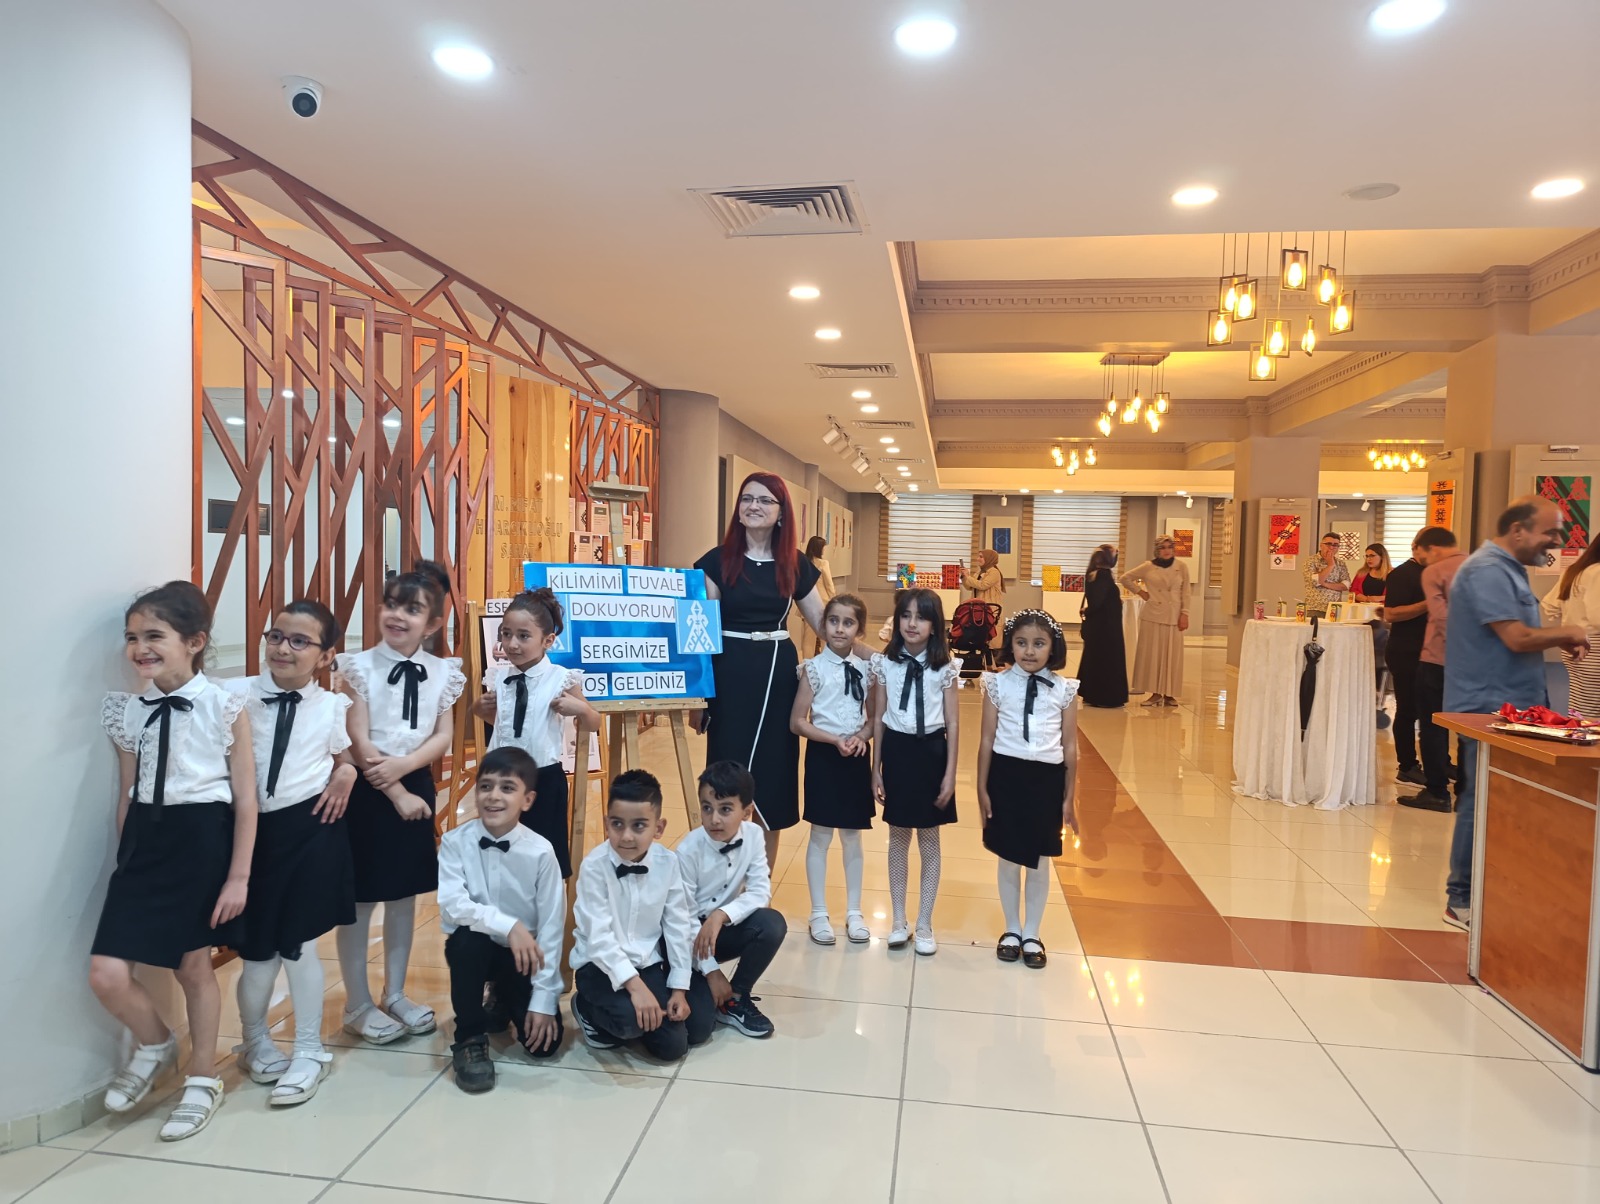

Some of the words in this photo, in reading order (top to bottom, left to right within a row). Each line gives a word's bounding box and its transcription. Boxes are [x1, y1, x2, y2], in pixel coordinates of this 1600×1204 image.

[550, 572, 621, 590] KİLİMİMİ
[629, 575, 684, 591] TUVALE
[487, 602, 511, 613] ESE
[571, 602, 675, 619] DOKUYORUM
[583, 641, 667, 659] SERGİMİZE
[581, 676, 606, 695] OŞ
[614, 672, 685, 691] GELDİNİZ
